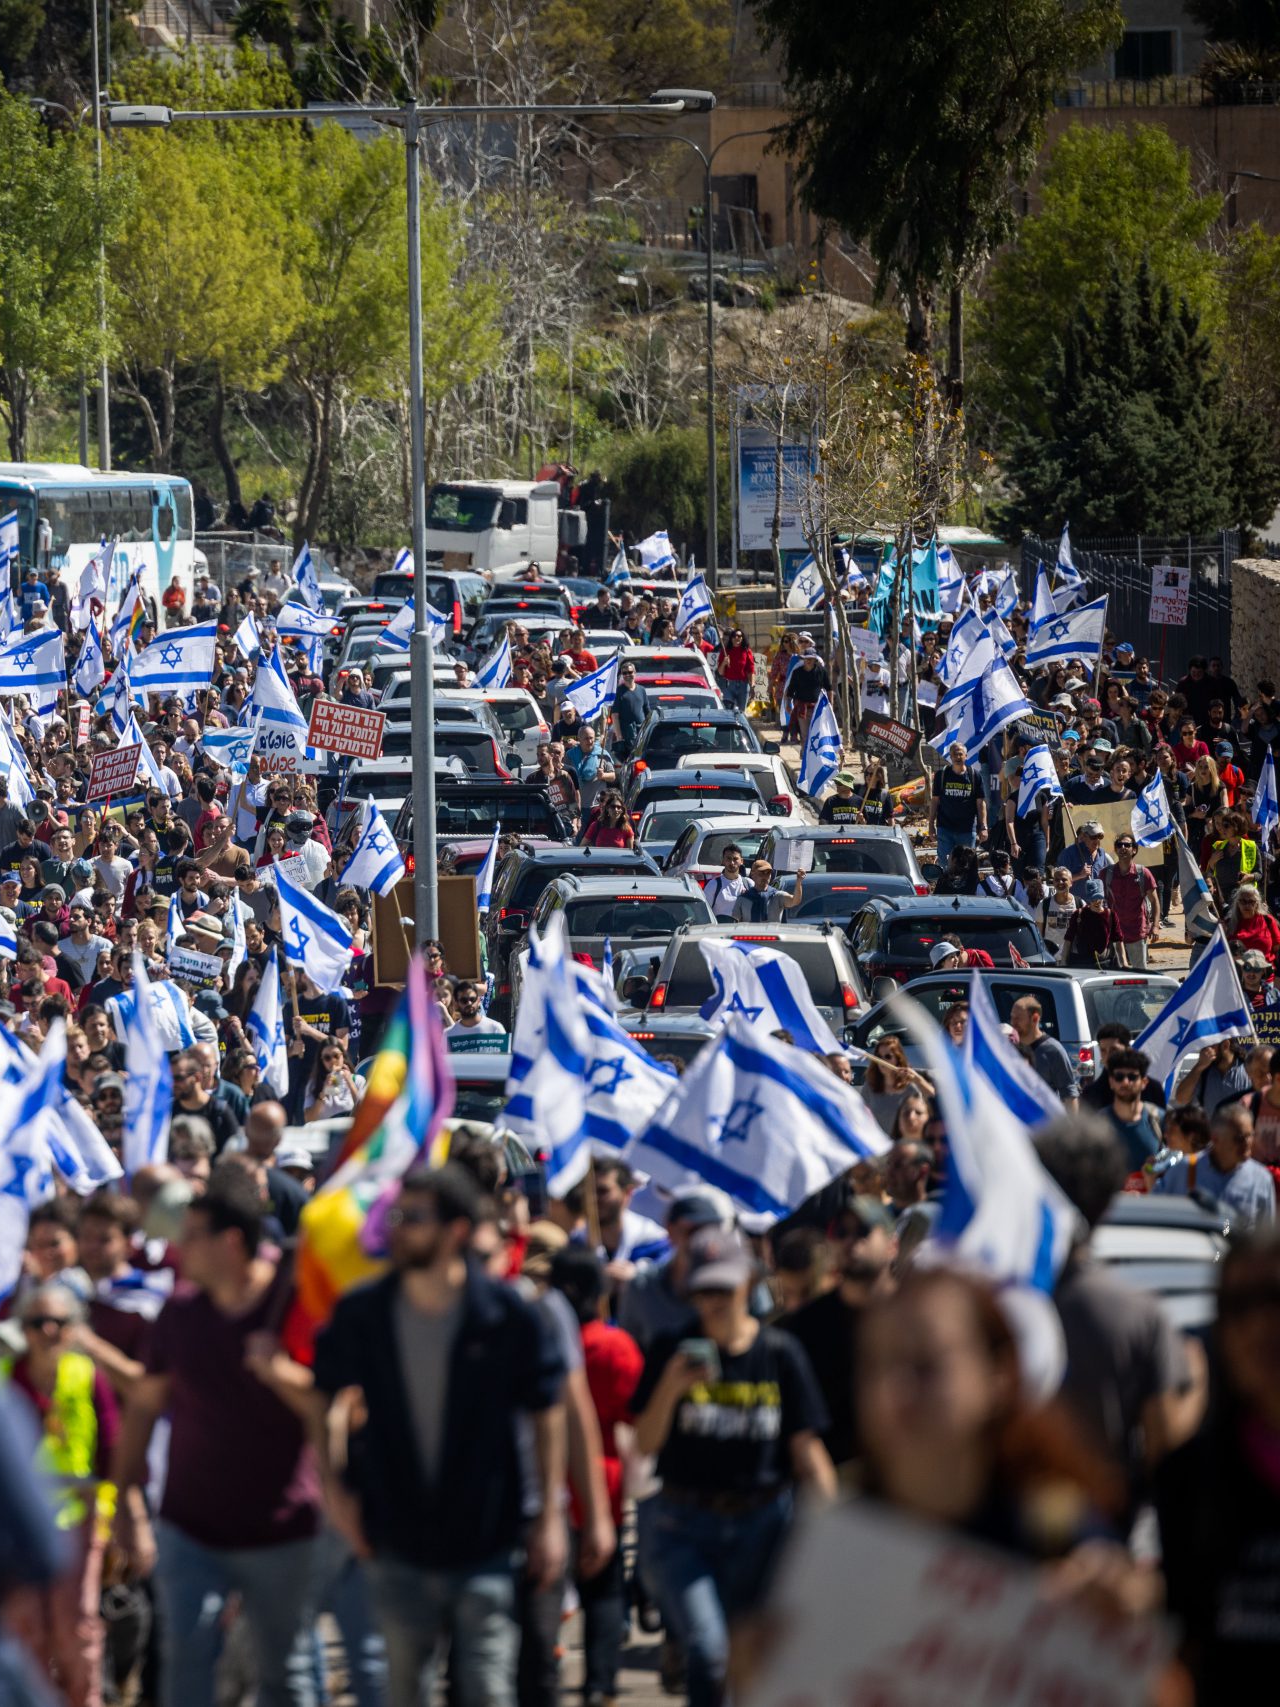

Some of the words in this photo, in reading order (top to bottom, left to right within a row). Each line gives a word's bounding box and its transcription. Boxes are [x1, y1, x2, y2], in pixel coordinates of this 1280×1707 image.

[317, 704, 381, 728] הרופאים
[315, 718, 330, 732] חיי
[331, 720, 343, 735] על
[344, 724, 378, 742] נלחמים
[890, 724, 911, 741] מחאת
[311, 733, 376, 757] הדמוקרטיה
[871, 724, 908, 750] הסטודנטים
[95, 746, 138, 769] הרופאים
[94, 770, 103, 781] חיי
[104, 765, 112, 779] על
[112, 760, 135, 776] נלחמים
[90, 773, 133, 796] הדמוקרטיה
[201, 961, 213, 969] אין
